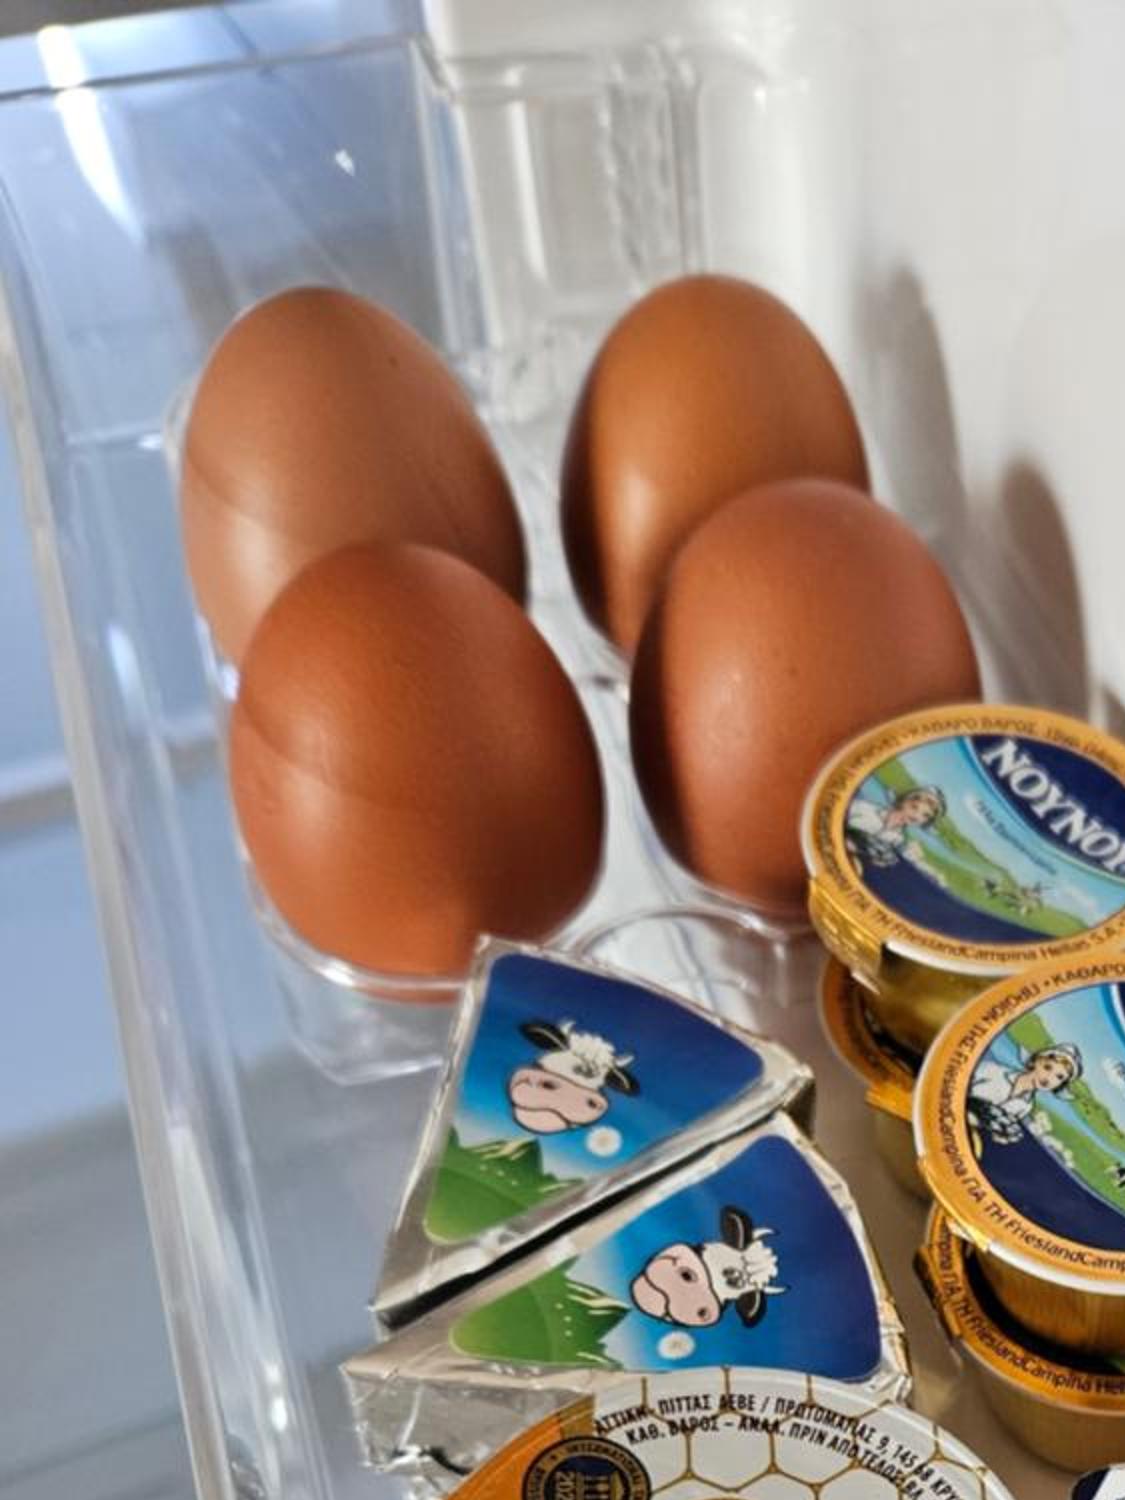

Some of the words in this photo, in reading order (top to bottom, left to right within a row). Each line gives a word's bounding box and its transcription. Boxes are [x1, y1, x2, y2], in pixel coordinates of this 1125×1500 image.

[658, 1394, 711, 1415] ΠΙΤΤΑΣ
[892, 1445, 921, 1470] 145
[667, 1415, 720, 1437] ΒΑΡΟΣ
[789, 1421, 826, 1446] ΠΡΙΝ
